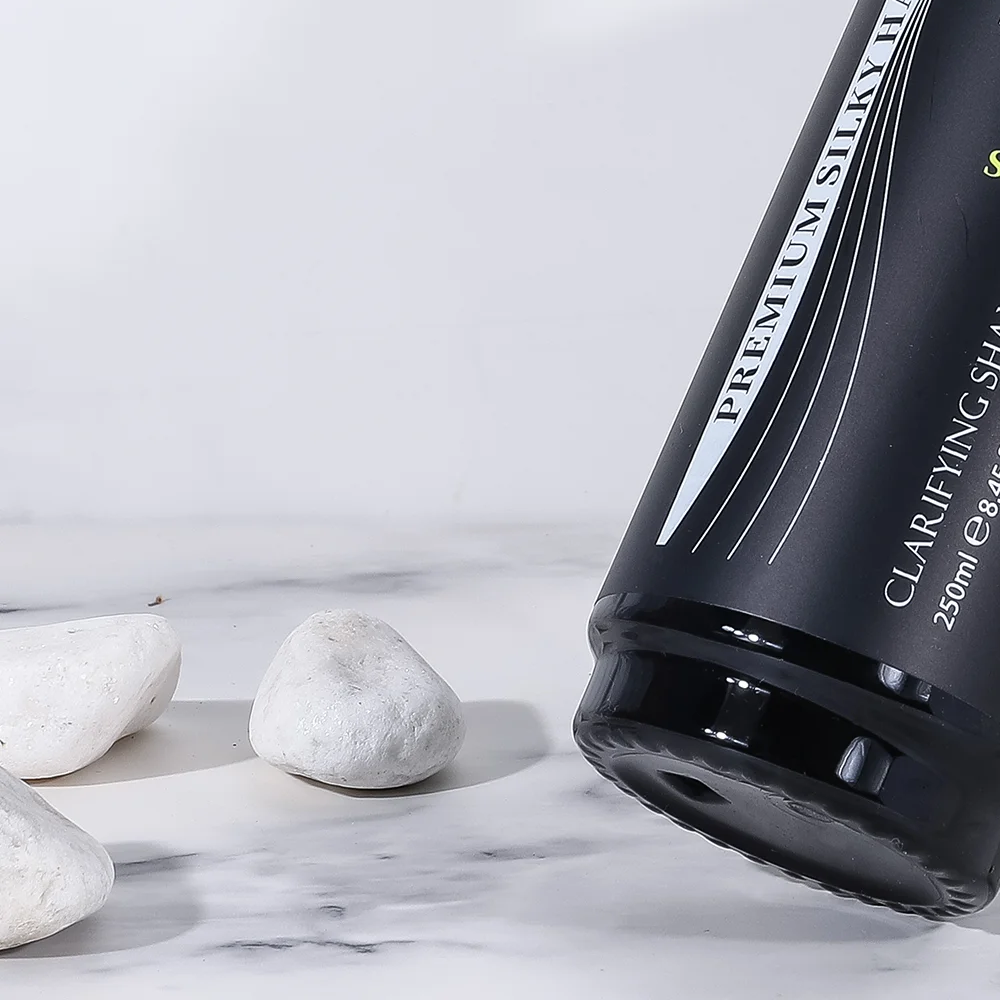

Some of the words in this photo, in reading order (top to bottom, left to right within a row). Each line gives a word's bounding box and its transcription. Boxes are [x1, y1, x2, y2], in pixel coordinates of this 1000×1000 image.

[713, 198, 829, 424] PREMIUM
[816, 56, 886, 186] SILKY
[884, 392, 990, 608] CLARIFYING
[932, 551, 979, 631] 250ml
